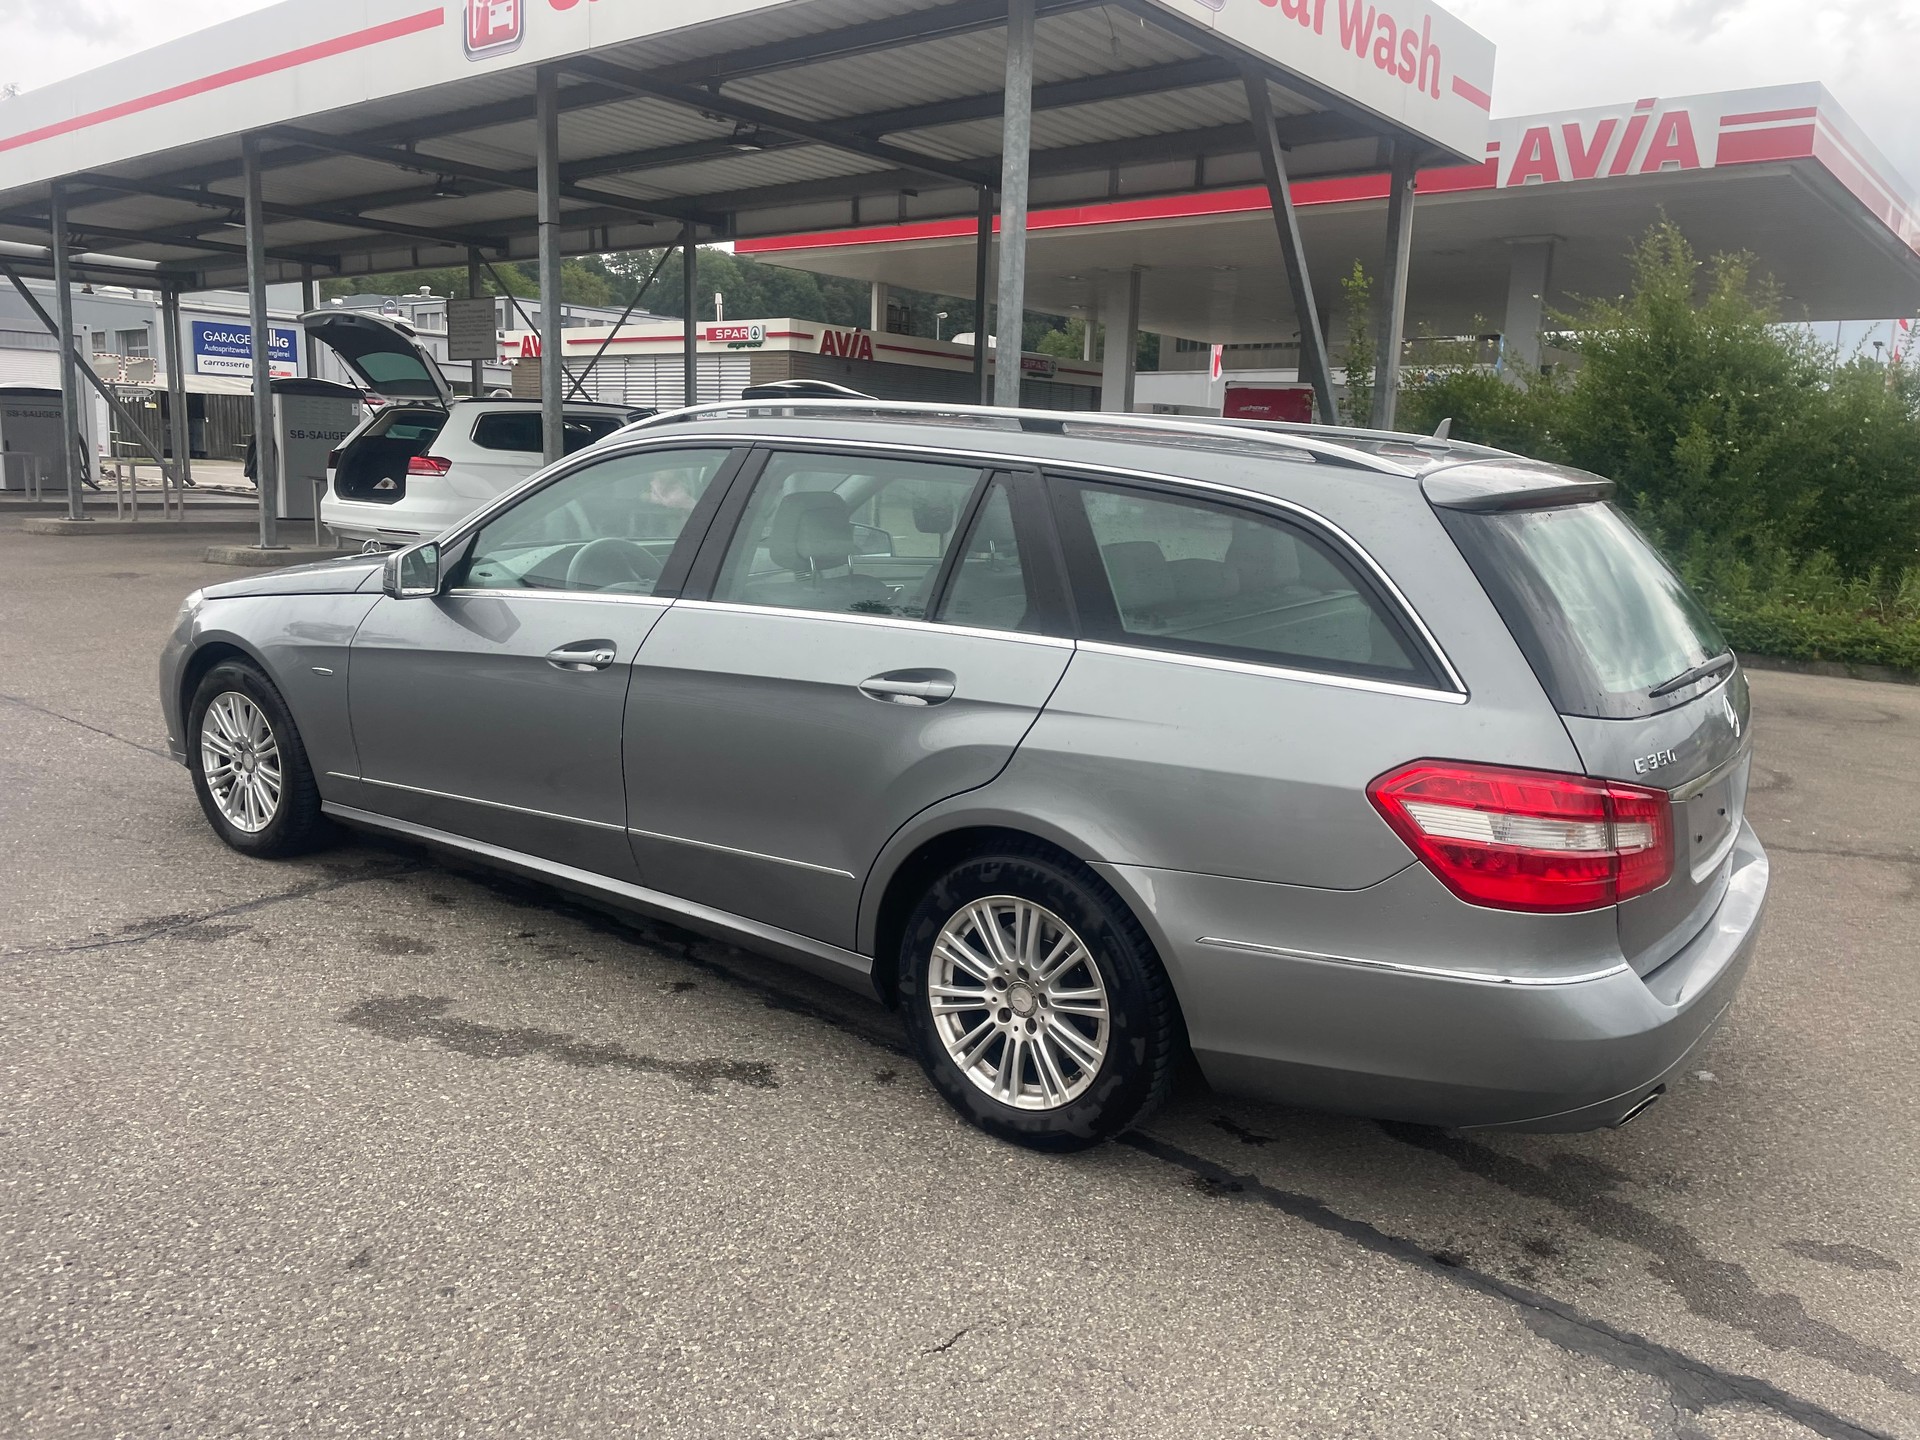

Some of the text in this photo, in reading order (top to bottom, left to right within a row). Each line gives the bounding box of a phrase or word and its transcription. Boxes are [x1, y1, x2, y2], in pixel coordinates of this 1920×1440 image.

[203, 331, 251, 345] GARAGE
[715, 328, 748, 339] SPAR
[204, 343, 250, 354] Autospritzwerk
[521, 335, 542, 358] AV
[203, 359, 250, 369] carrosserie
[290, 429, 351, 440] SB-SAUGE
[1634, 757, 1647, 774] E
